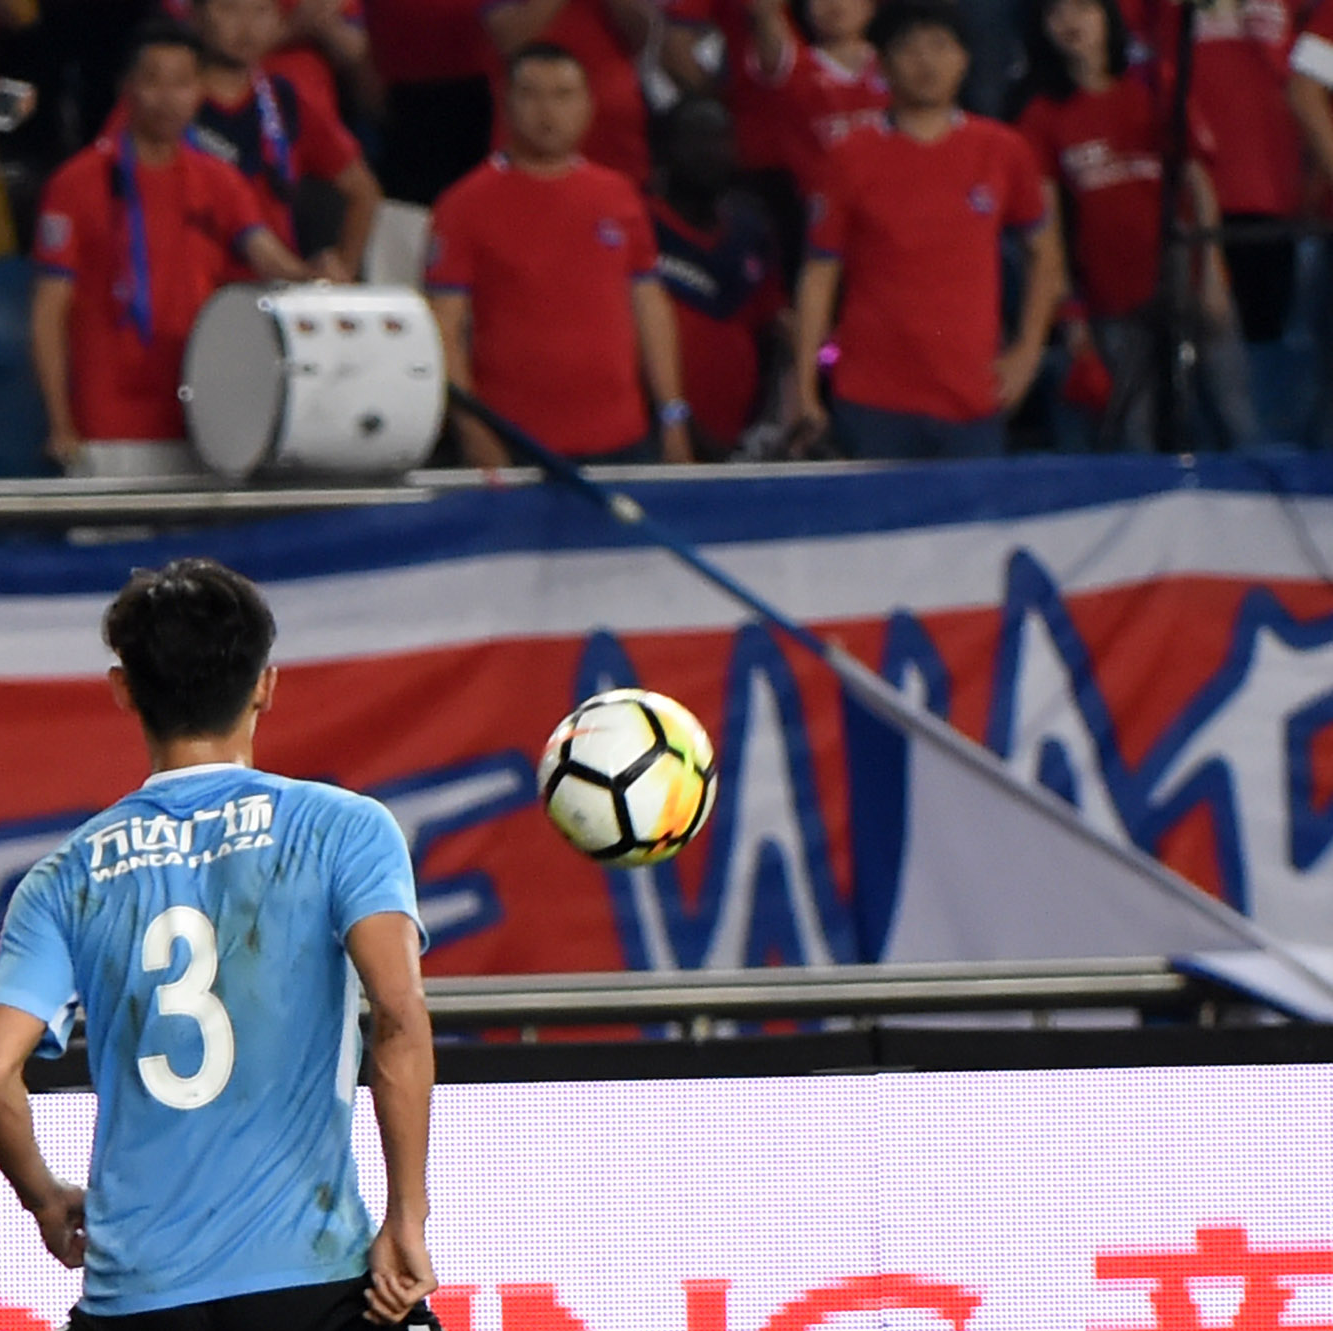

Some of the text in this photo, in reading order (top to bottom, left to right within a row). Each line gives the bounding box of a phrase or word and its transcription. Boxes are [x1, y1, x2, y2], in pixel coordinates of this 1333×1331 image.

[85, 793, 274, 868] 万达广场
[187, 833, 275, 869] PLAZA
[137, 905, 234, 1110] 3
